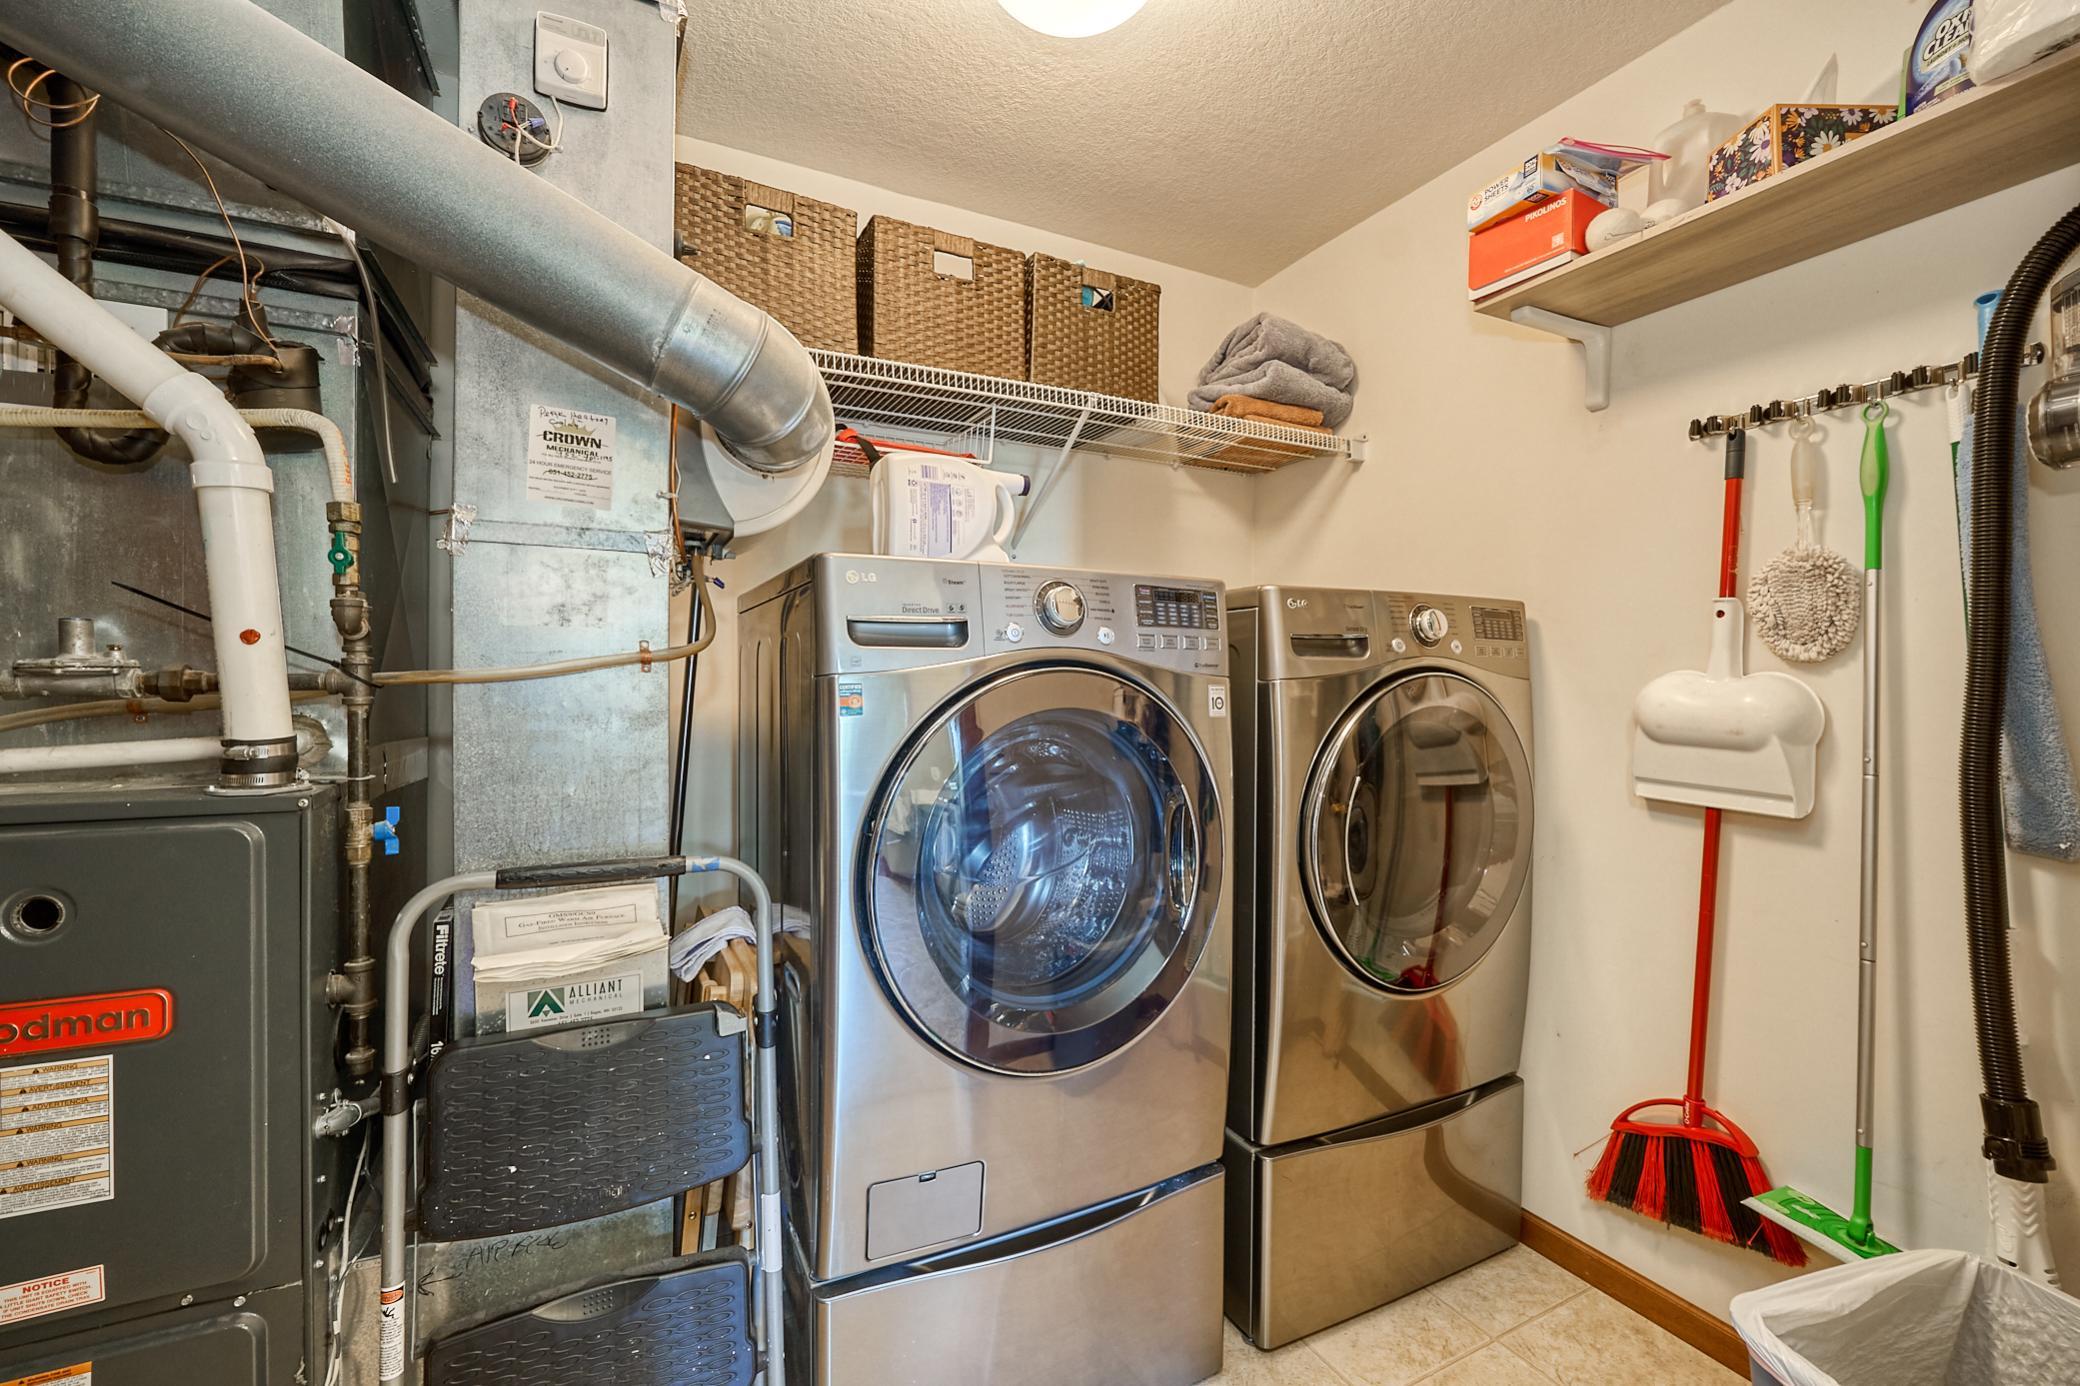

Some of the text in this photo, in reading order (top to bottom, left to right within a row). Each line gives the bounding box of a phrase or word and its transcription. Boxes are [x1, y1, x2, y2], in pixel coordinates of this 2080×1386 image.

[1484, 176, 1509, 196] POWER
[1484, 184, 1509, 200] SHEETS
[1524, 197, 1568, 222] PIKOLINOS
[542, 430, 602, 449] CROWN
[546, 444, 598, 457] MECHANICAL
[434, 925, 449, 975] Filtrete
[569, 979, 623, 998] ALLIANT
[570, 994, 623, 1004] MECHANICAL
[0, 1008, 150, 1044] odman
[42, 1064, 78, 1072] WARNING
[29, 1080, 90, 1093] AVERTISSEMENT
[32, 1097, 89, 1110] ADVERTENCIA
[26, 1122, 62, 1133] WARNING
[26, 1155, 62, 1166] WARNING
[14, 1176, 76, 1192] AVERTISSEMENT
[22, 1278, 69, 1294] NOTICE
